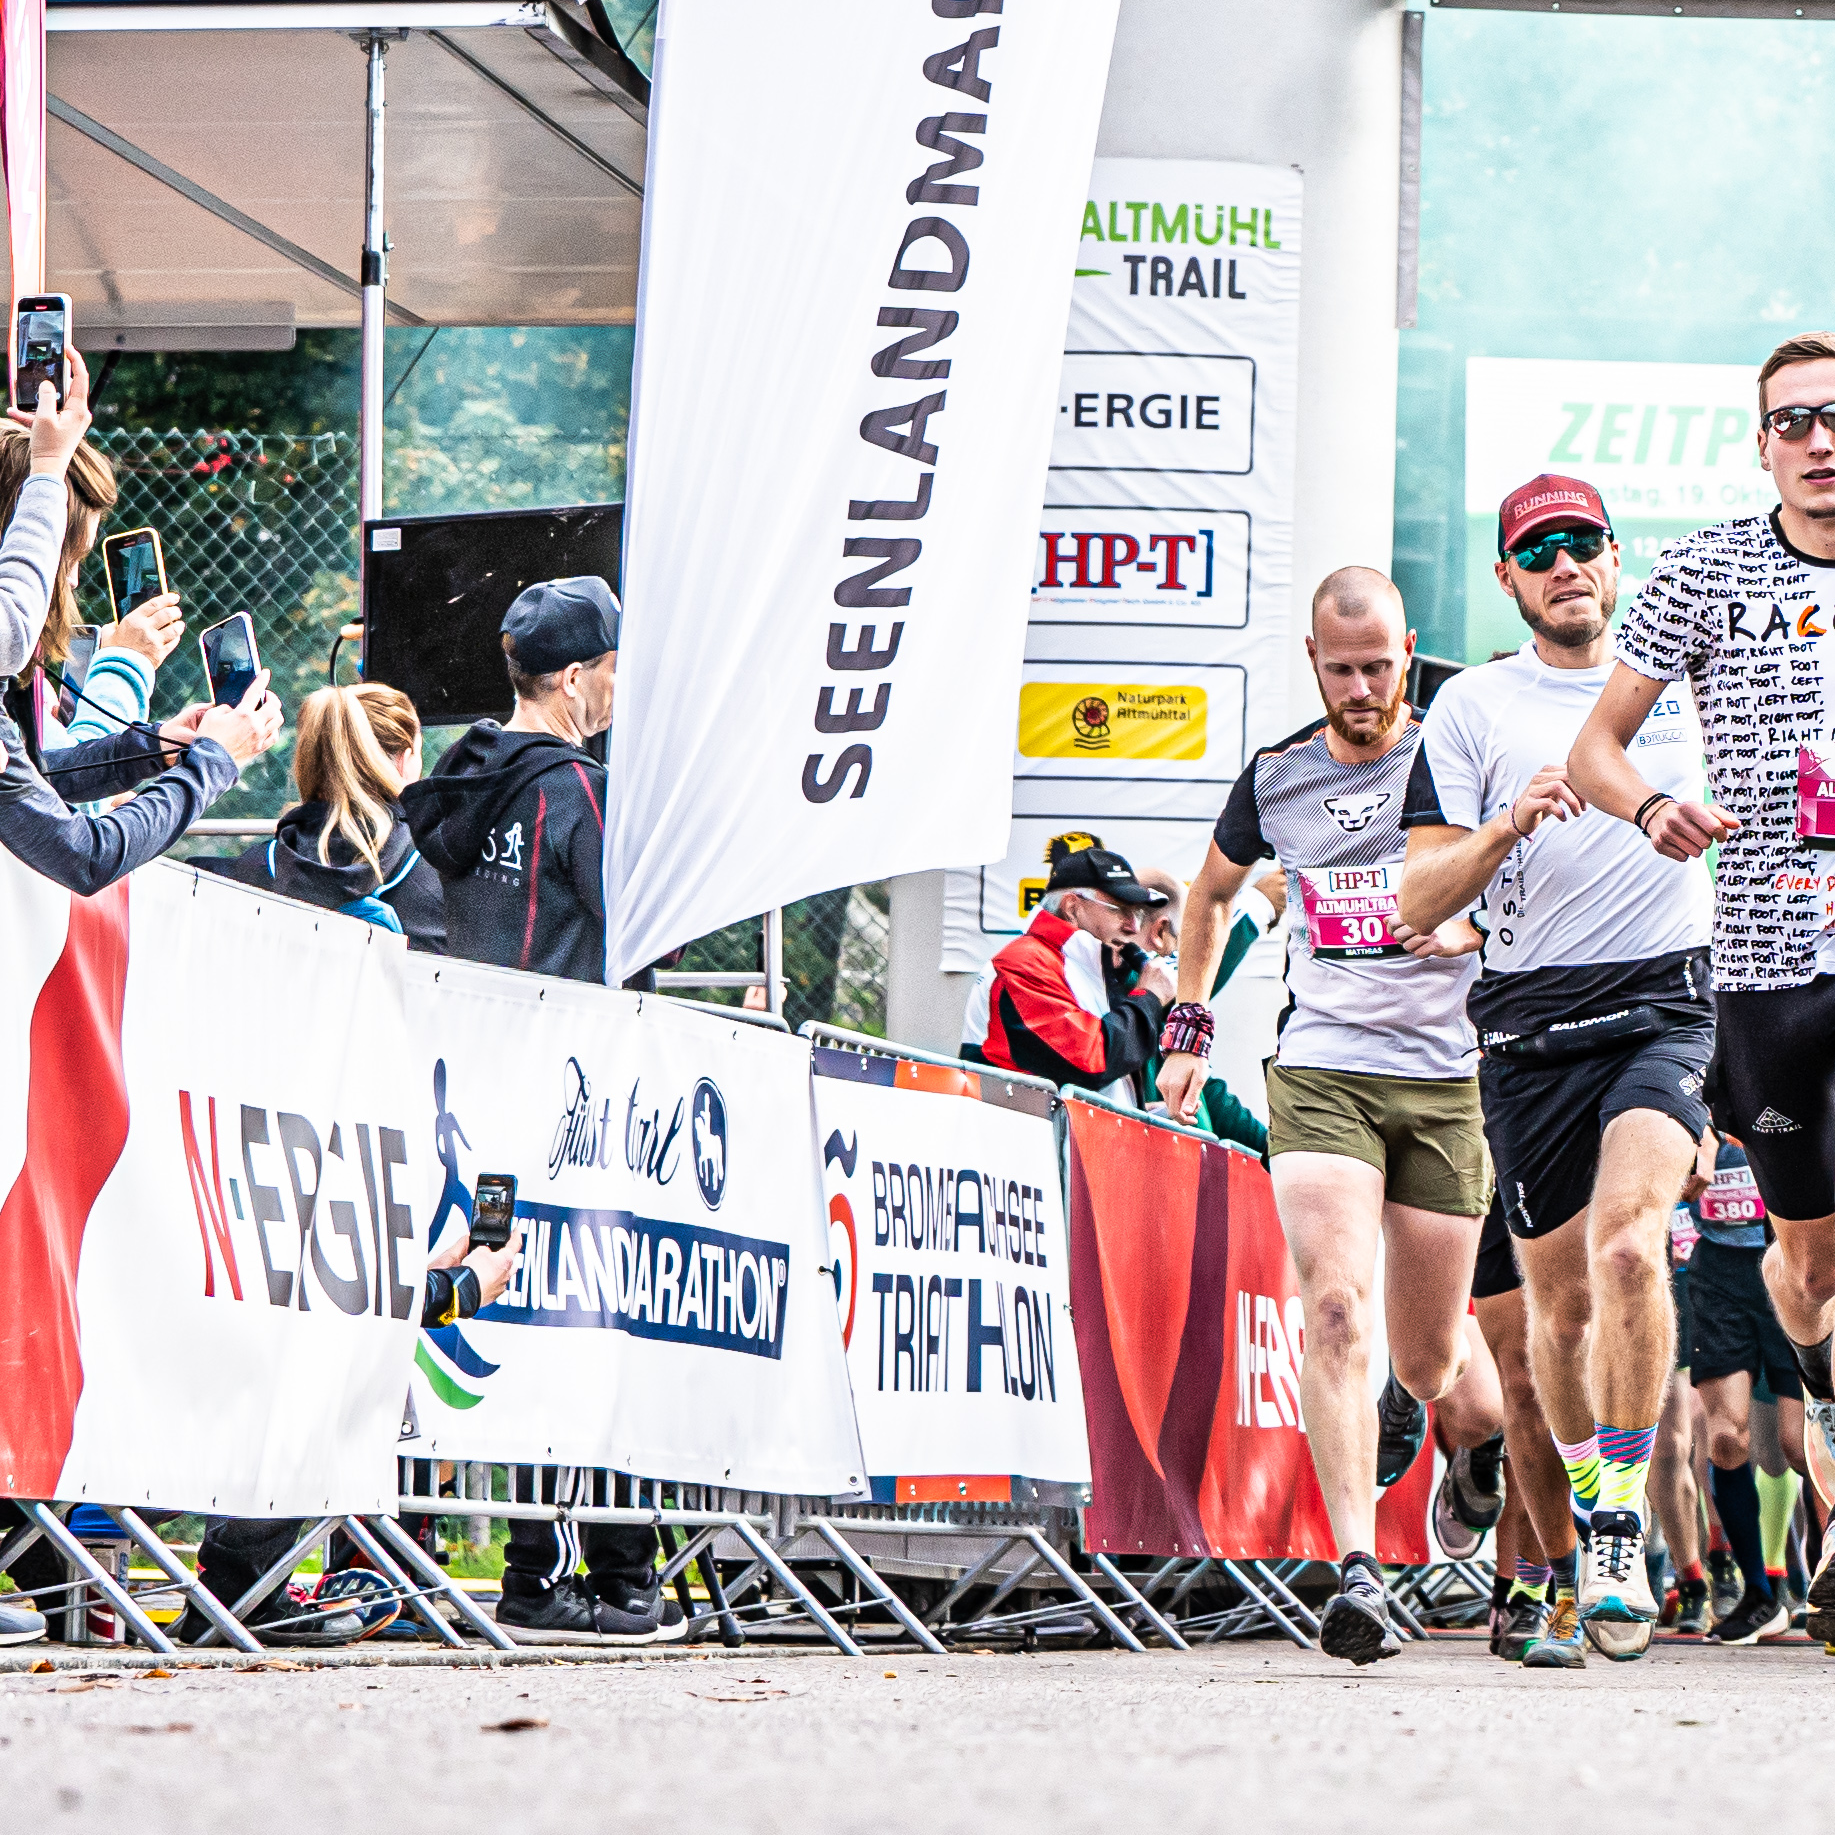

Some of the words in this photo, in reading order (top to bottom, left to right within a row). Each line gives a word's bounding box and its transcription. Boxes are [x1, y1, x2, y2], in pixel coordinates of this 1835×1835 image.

[1123, 254, 1247, 300] TRAIL
[1548, 401, 1758, 467] ZEITP
[1719, 484, 1779, 507] Okto
[1031, 529, 1214, 598] HP-T]
[1789, 642, 1817, 653] FOOT
[1790, 660, 1819, 671] FOOT
[1117, 691, 1187, 706] Naturpark
[1768, 727, 1823, 745] RIGHT
[1775, 873, 1821, 891] EVERY
[1341, 916, 1384, 944] 30
[1549, 1009, 1629, 1032] SALOMON
[1713, 1200, 1757, 1219] 380
